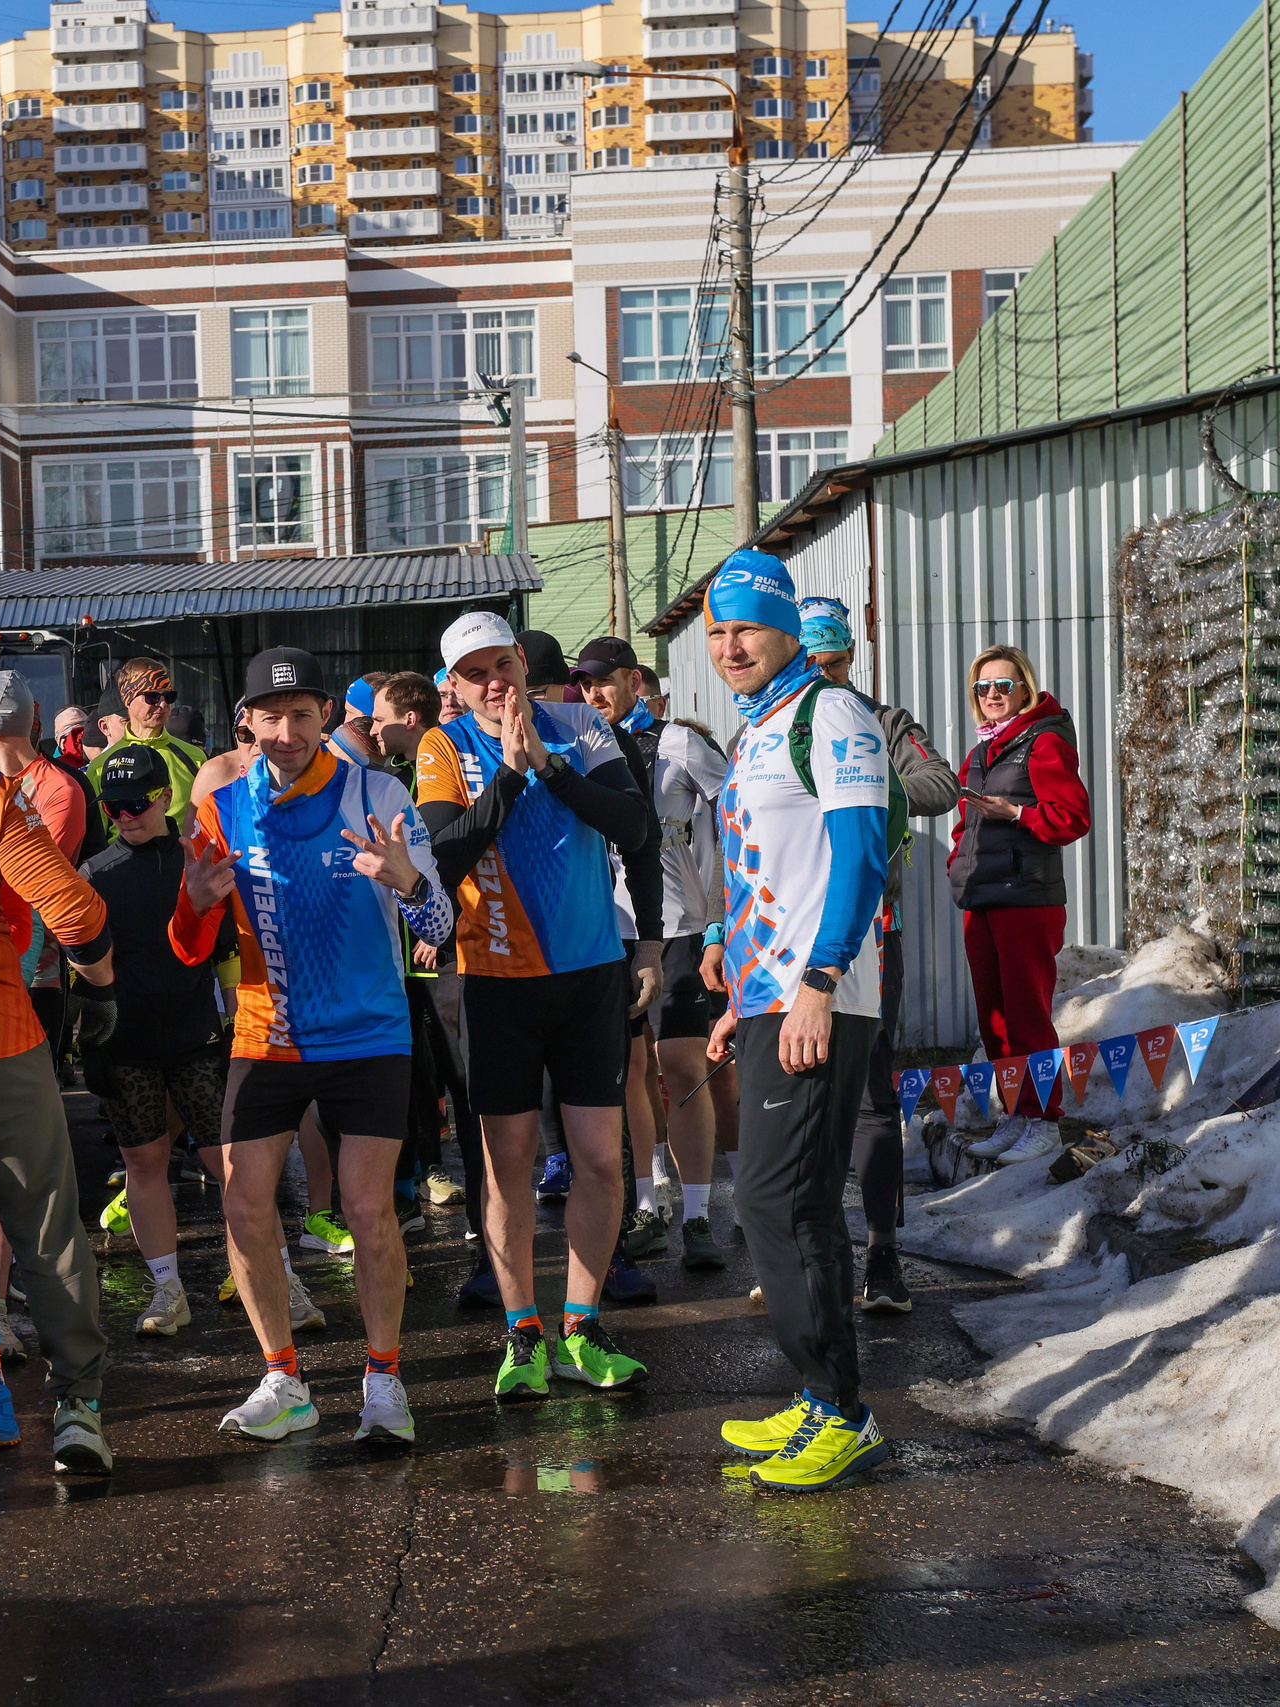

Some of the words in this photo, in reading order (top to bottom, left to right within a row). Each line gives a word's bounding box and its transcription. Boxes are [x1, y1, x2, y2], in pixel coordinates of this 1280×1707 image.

[754, 575, 779, 588] RUN
[750, 763, 766, 772] Boris
[836, 767, 861, 776] RUN
[835, 775, 885, 785] ZEPPELIN
[410, 826, 427, 838] RUN
[248, 846, 289, 989] ZEPPELIN
[489, 901, 511, 956] RUN
[268, 992, 291, 1047] RUN
